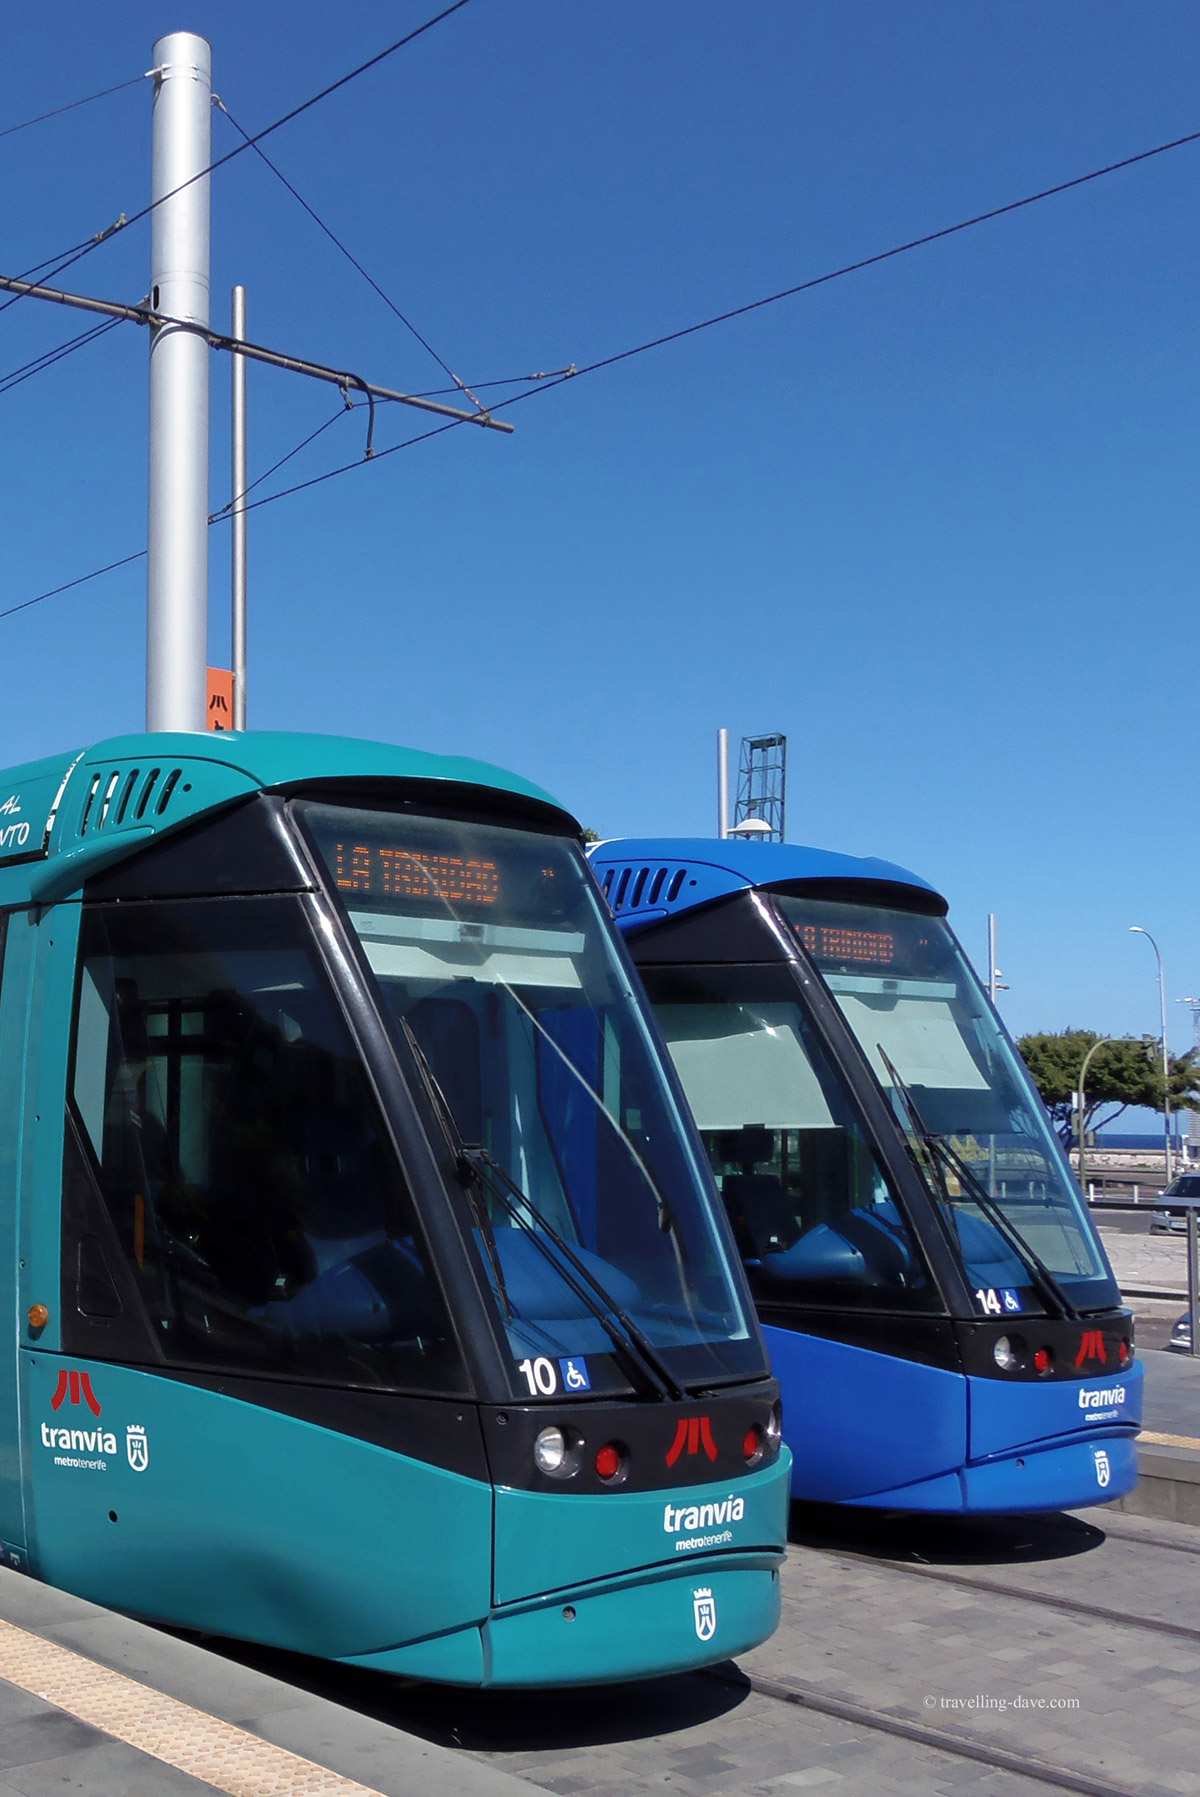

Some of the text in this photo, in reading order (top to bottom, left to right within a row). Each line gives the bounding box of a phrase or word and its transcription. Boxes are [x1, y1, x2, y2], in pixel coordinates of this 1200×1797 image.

[337, 844, 498, 903] LA TRINIDAD
[976, 1288, 1001, 1314] 14
[518, 1357, 557, 1396] 10
[40, 1422, 117, 1455] tranvía
[54, 1456, 107, 1471] metrotenerife
[663, 1494, 745, 1533] tranvía
[675, 1530, 733, 1551] metrotenerife
